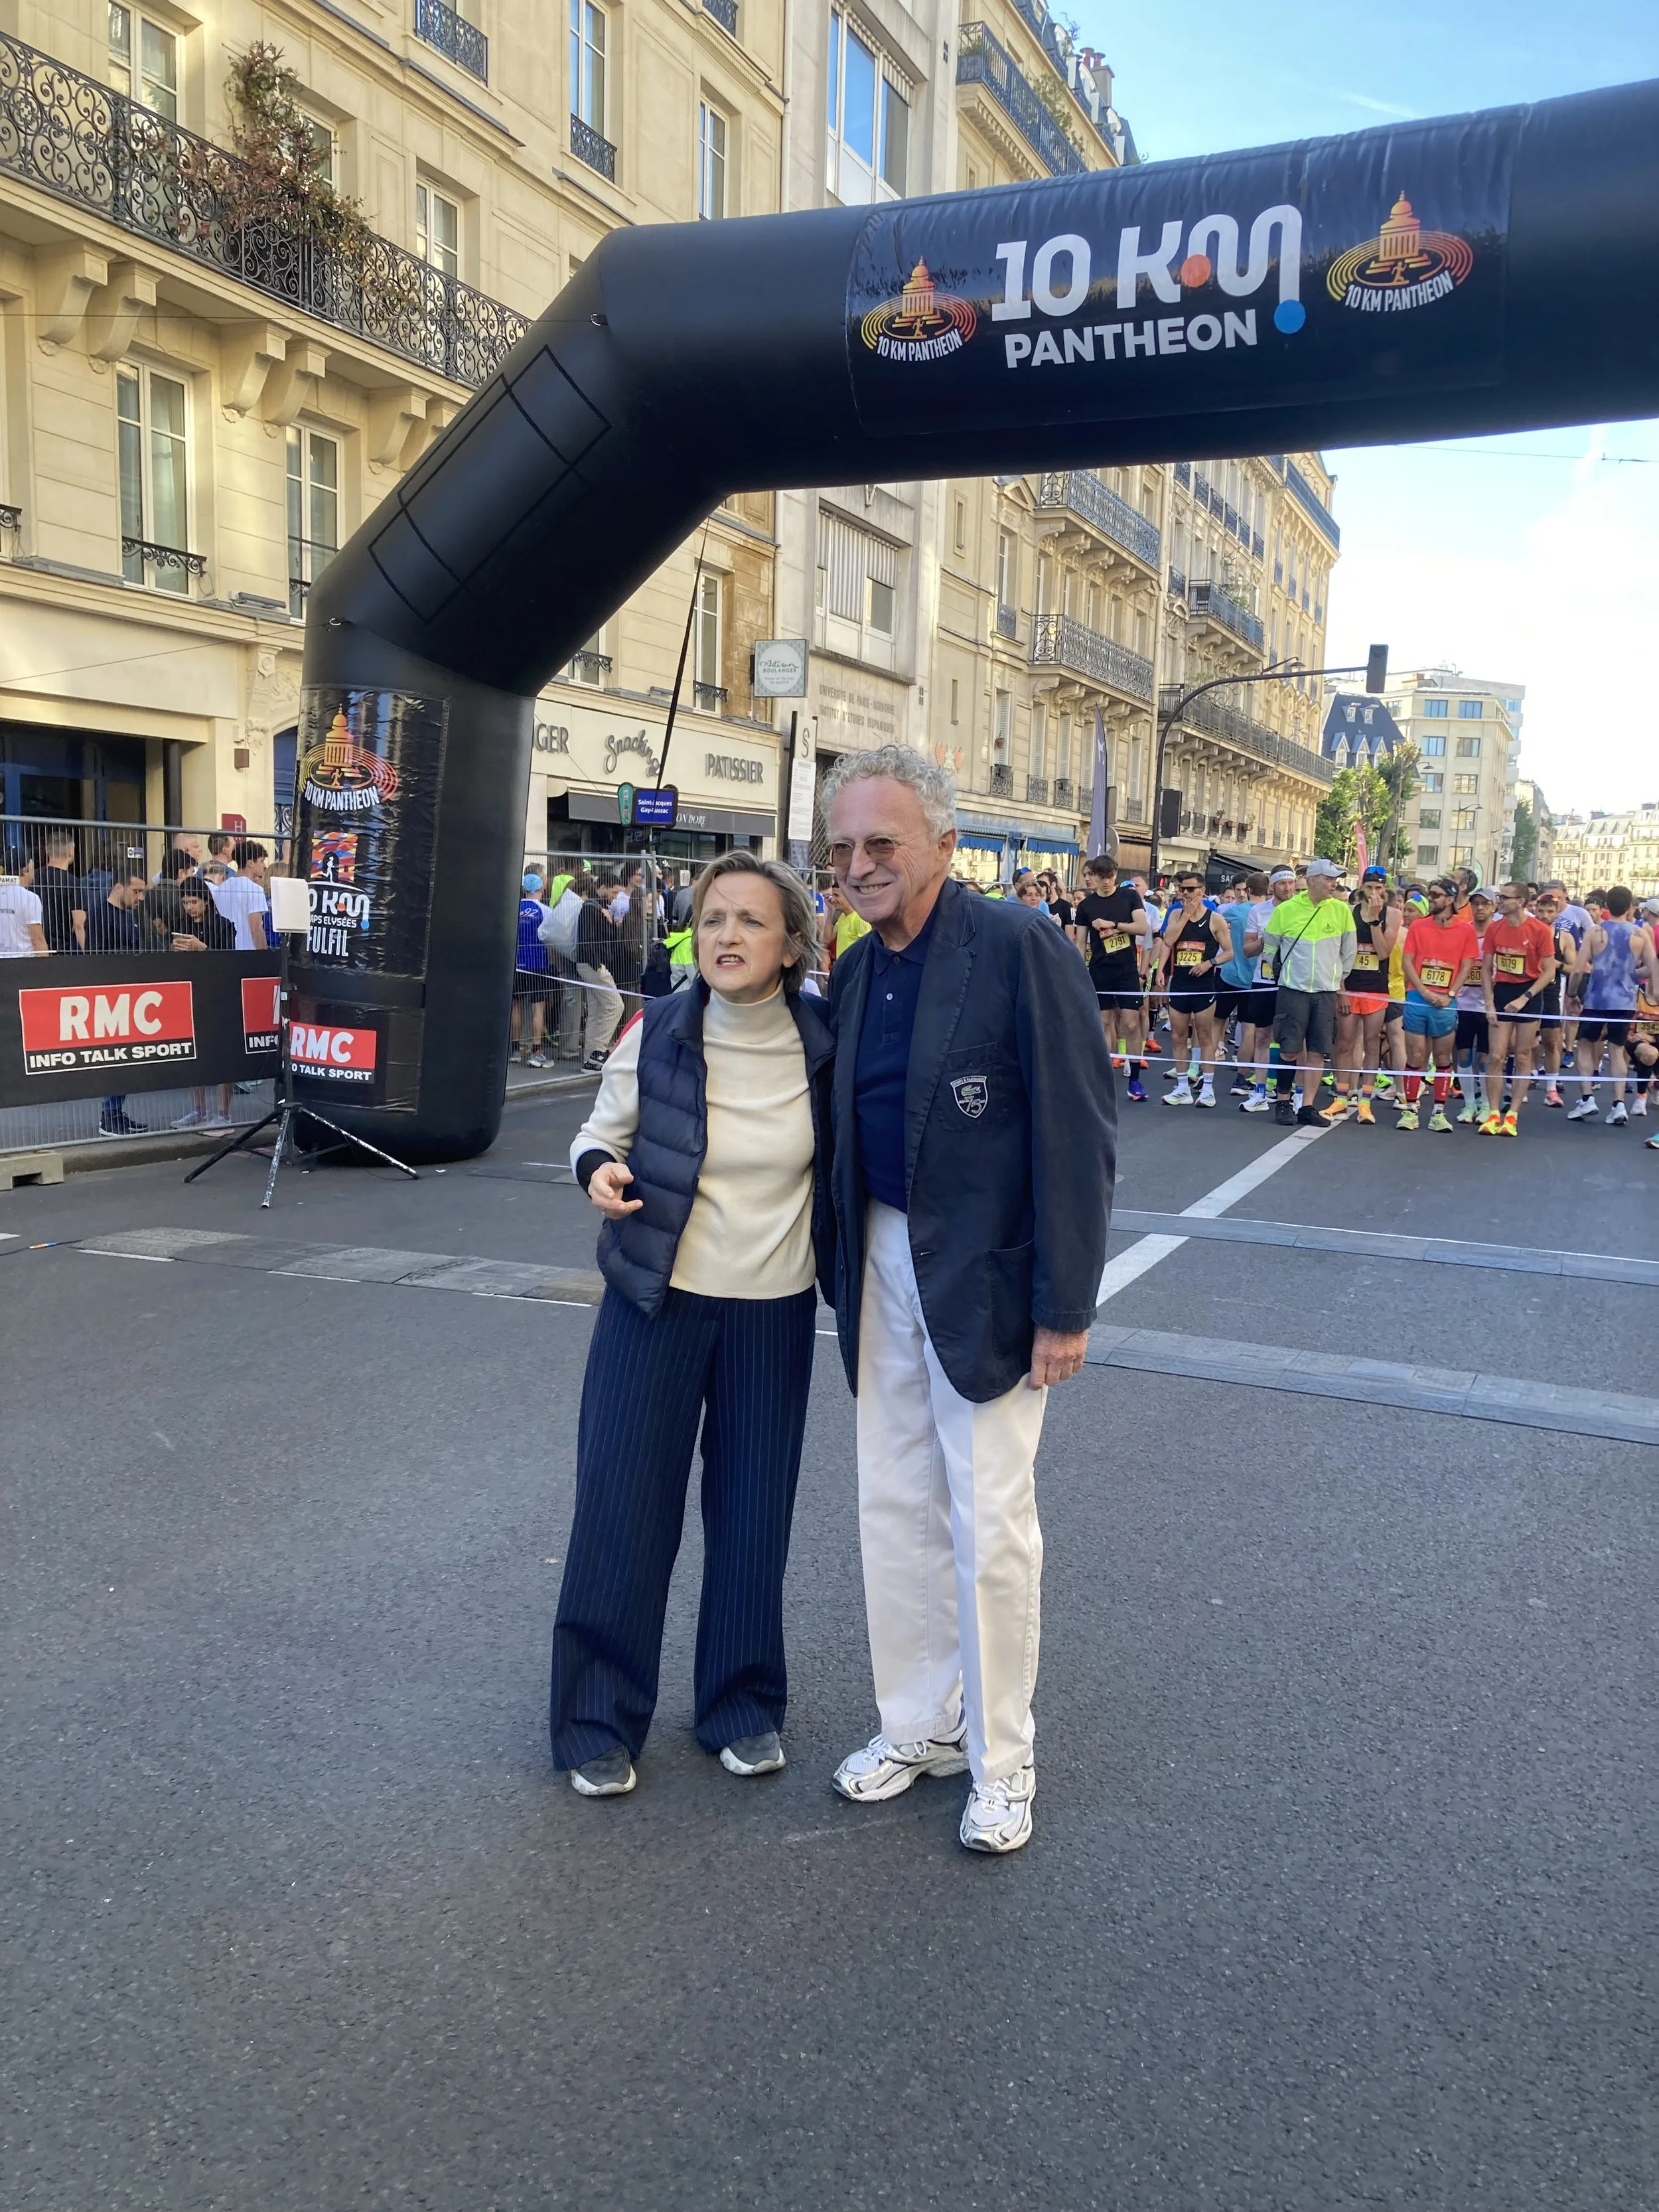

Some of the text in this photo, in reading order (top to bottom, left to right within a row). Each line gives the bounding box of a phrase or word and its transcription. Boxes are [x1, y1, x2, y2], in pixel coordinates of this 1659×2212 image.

[992, 234, 1091, 322] 10
[1344, 269, 1454, 312] 10 KM PANTHEON
[877, 328, 963, 362] 10 KM PANTHEON
[1005, 309, 1258, 368] PANTHEON
[849, 692, 855, 704] DE
[819, 704, 839, 719] INSTITUT
[534, 723, 569, 754] GER
[705, 753, 763, 784] PATISSIER
[305, 780, 380, 811] 10 KM PANTHEON
[676, 813, 687, 823] ON
[308, 888, 318, 912] 0
[323, 916, 357, 928] ELYSÉES
[307, 926, 349, 957] FULFIL
[1109, 935, 1125, 948] 2791
[1179, 952, 1197, 962] 3225
[1358, 956, 1369, 966] 45
[1500, 957, 1517, 970] 6179
[1426, 970, 1445, 982] 6178
[60, 991, 163, 1041] RMC
[29, 1042, 192, 1069] INFO TALK SPORT
[291, 1026, 354, 1063] RMC
[299, 1064, 325, 1076] TALK
[328, 1069, 372, 1080] SPORT
[964, 1095, 981, 1114] 75
